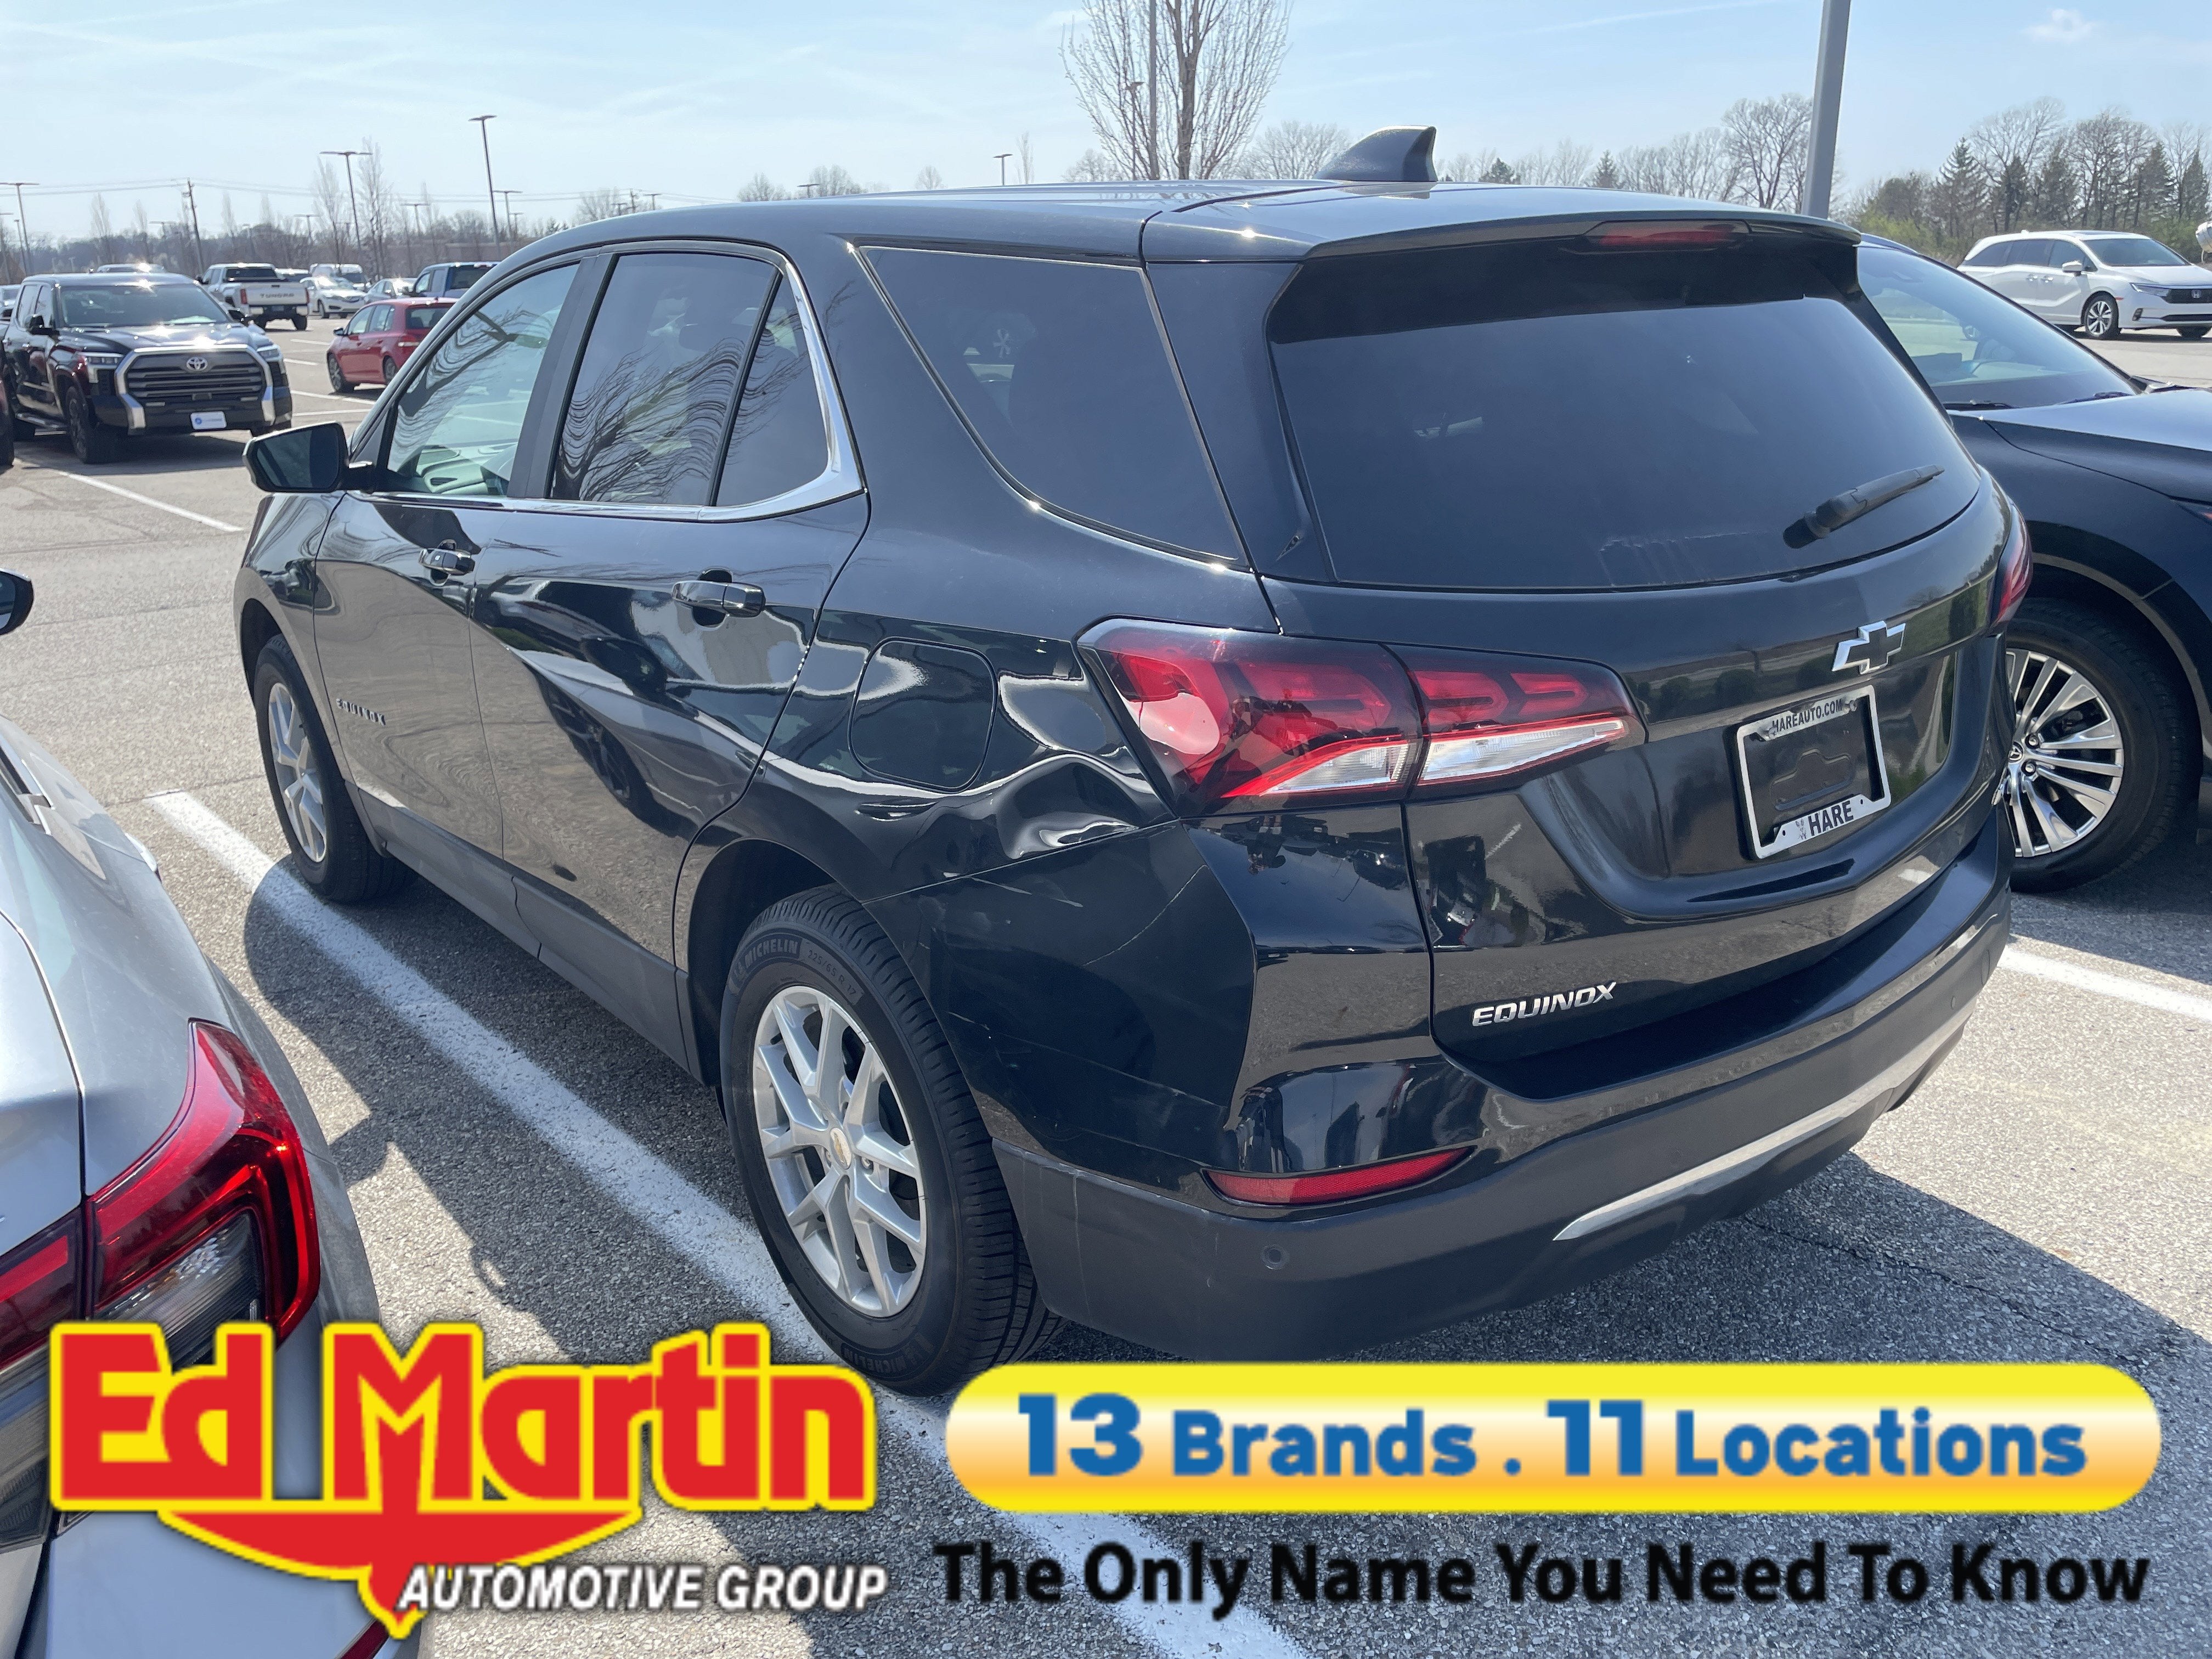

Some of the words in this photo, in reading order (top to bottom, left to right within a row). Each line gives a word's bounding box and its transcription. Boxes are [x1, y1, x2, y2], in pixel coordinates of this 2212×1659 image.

[335, 698, 386, 727] EQUINOX
[1771, 698, 1844, 734] HAREAUTO.COM
[1808, 799, 1854, 837] HARE
[744, 938, 799, 969] MICHELIN
[807, 949, 837, 977] 225/65
[838, 974, 845, 985] R
[847, 984, 857, 995] 17
[1472, 981, 1617, 1027] EQUINOX
